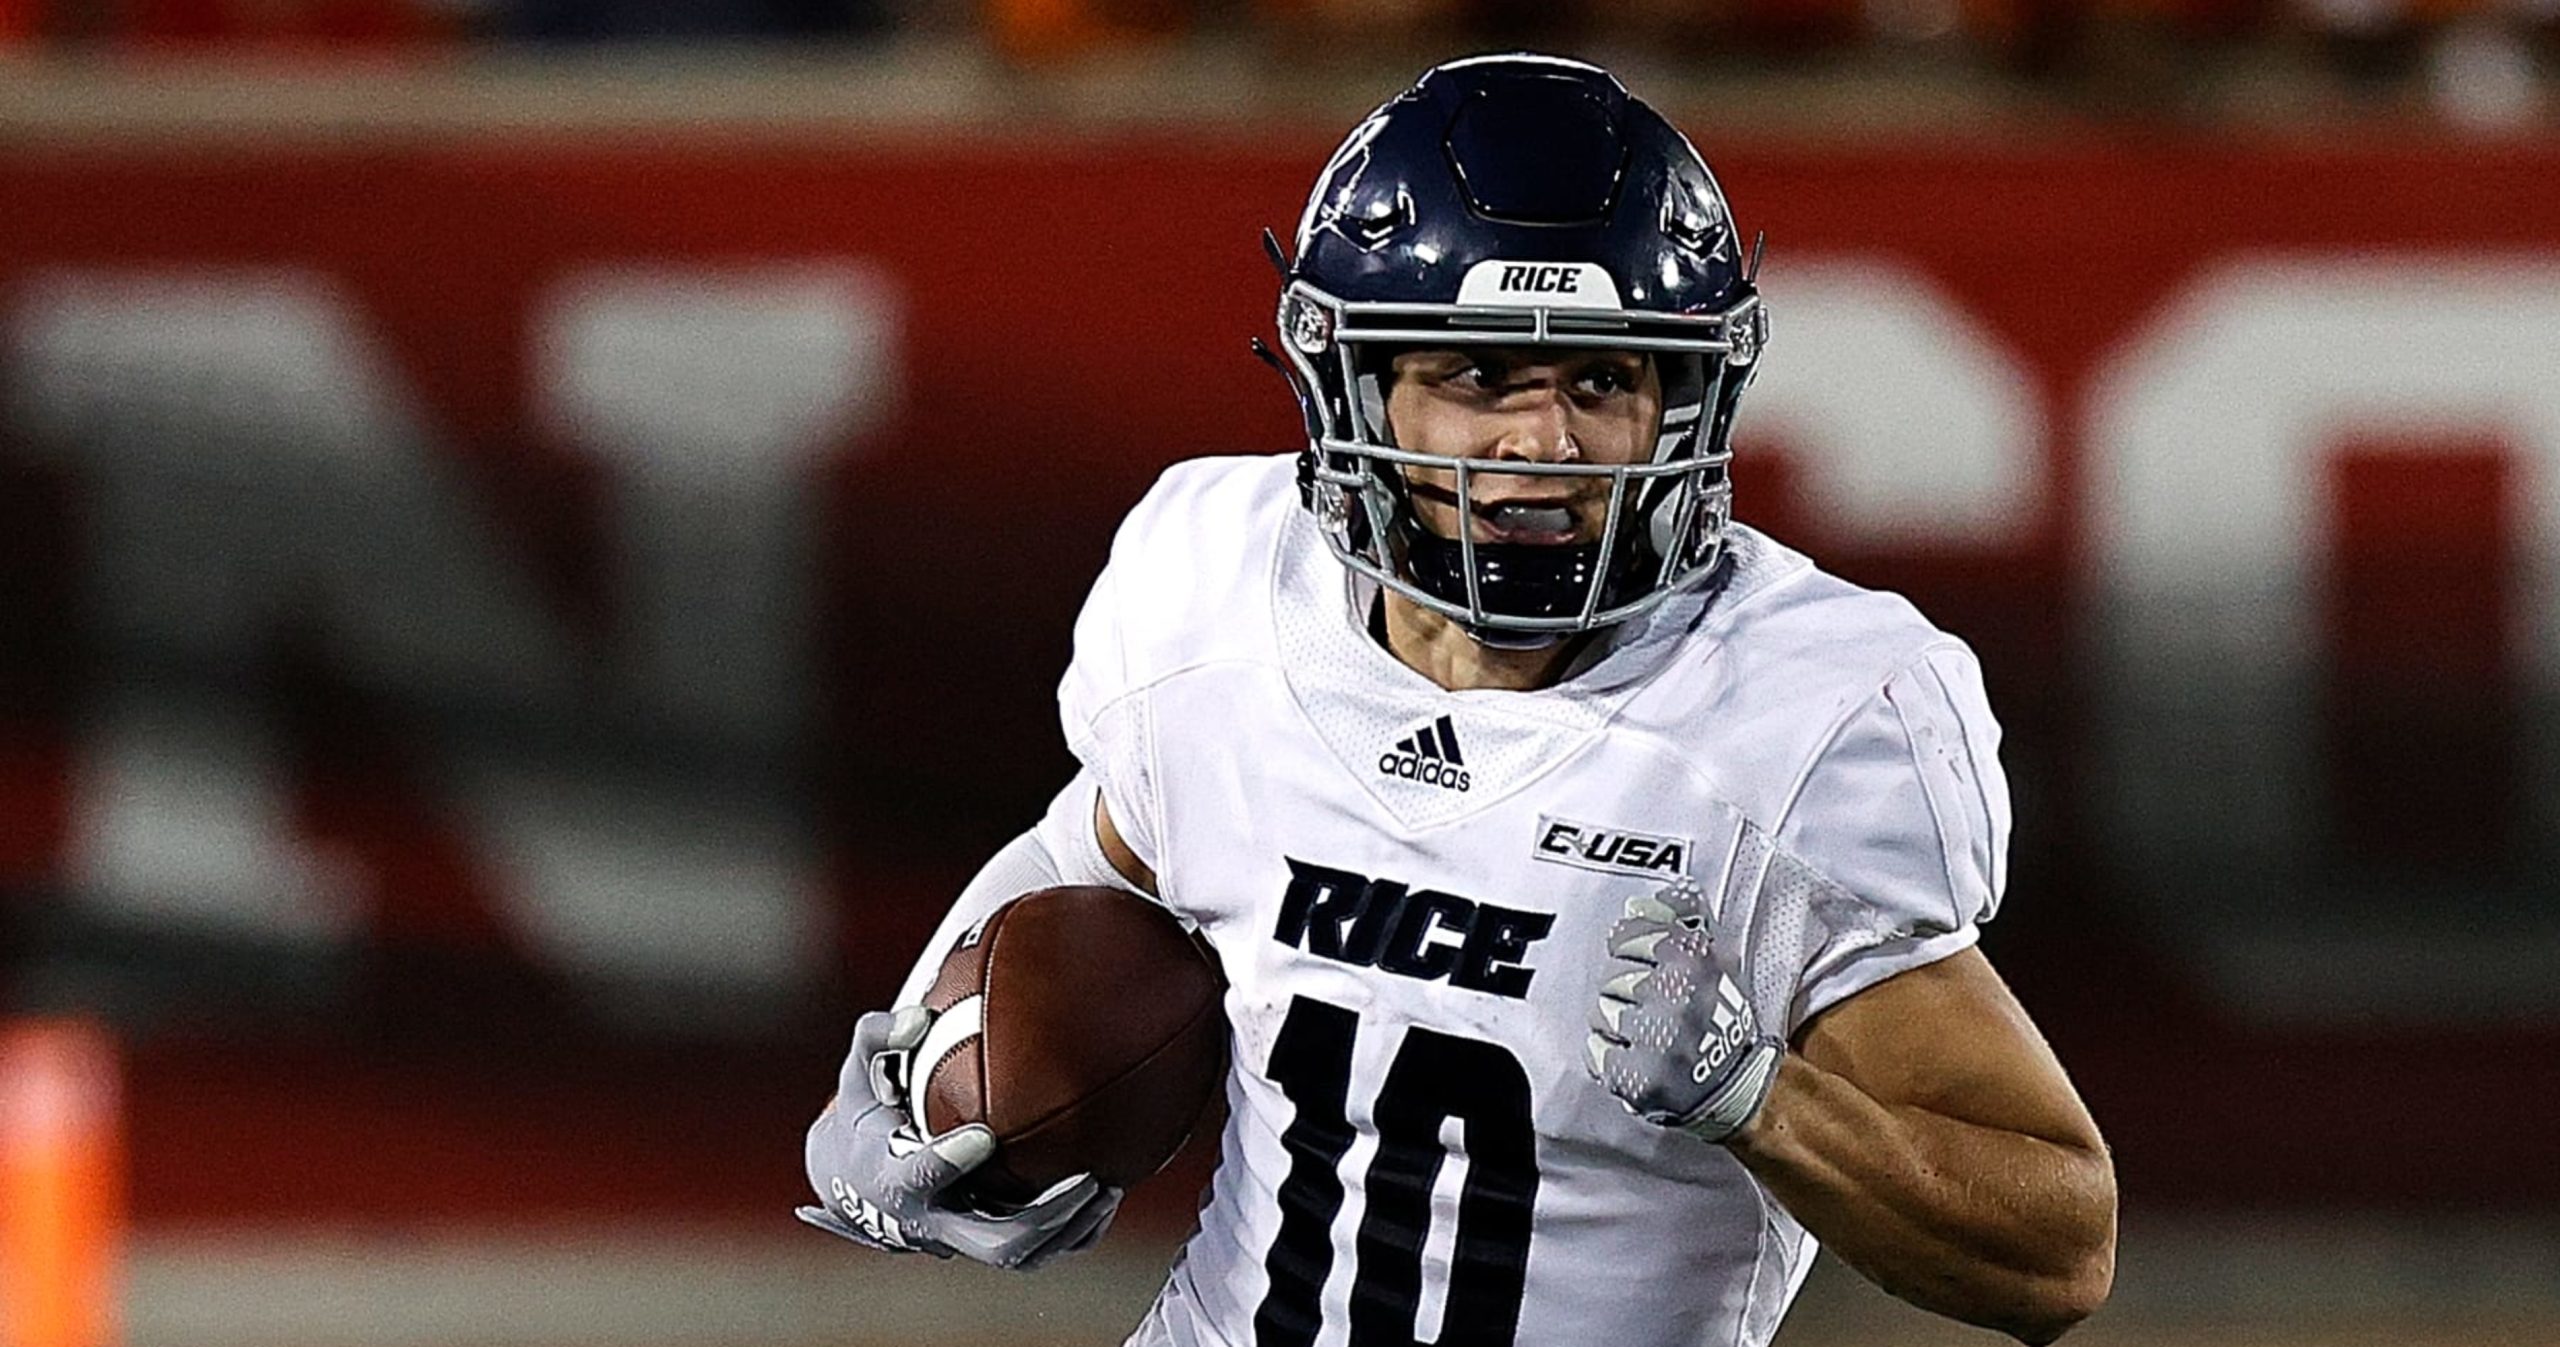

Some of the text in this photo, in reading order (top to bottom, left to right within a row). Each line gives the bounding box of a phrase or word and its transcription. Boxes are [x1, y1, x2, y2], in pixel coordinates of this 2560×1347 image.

[1499, 266, 1582, 292] RICE
[1379, 752, 1471, 793] adidas
[1273, 856, 1557, 1000] RICE
[1693, 1000, 1752, 1083] adida
[1254, 994, 1540, 1347] 10
